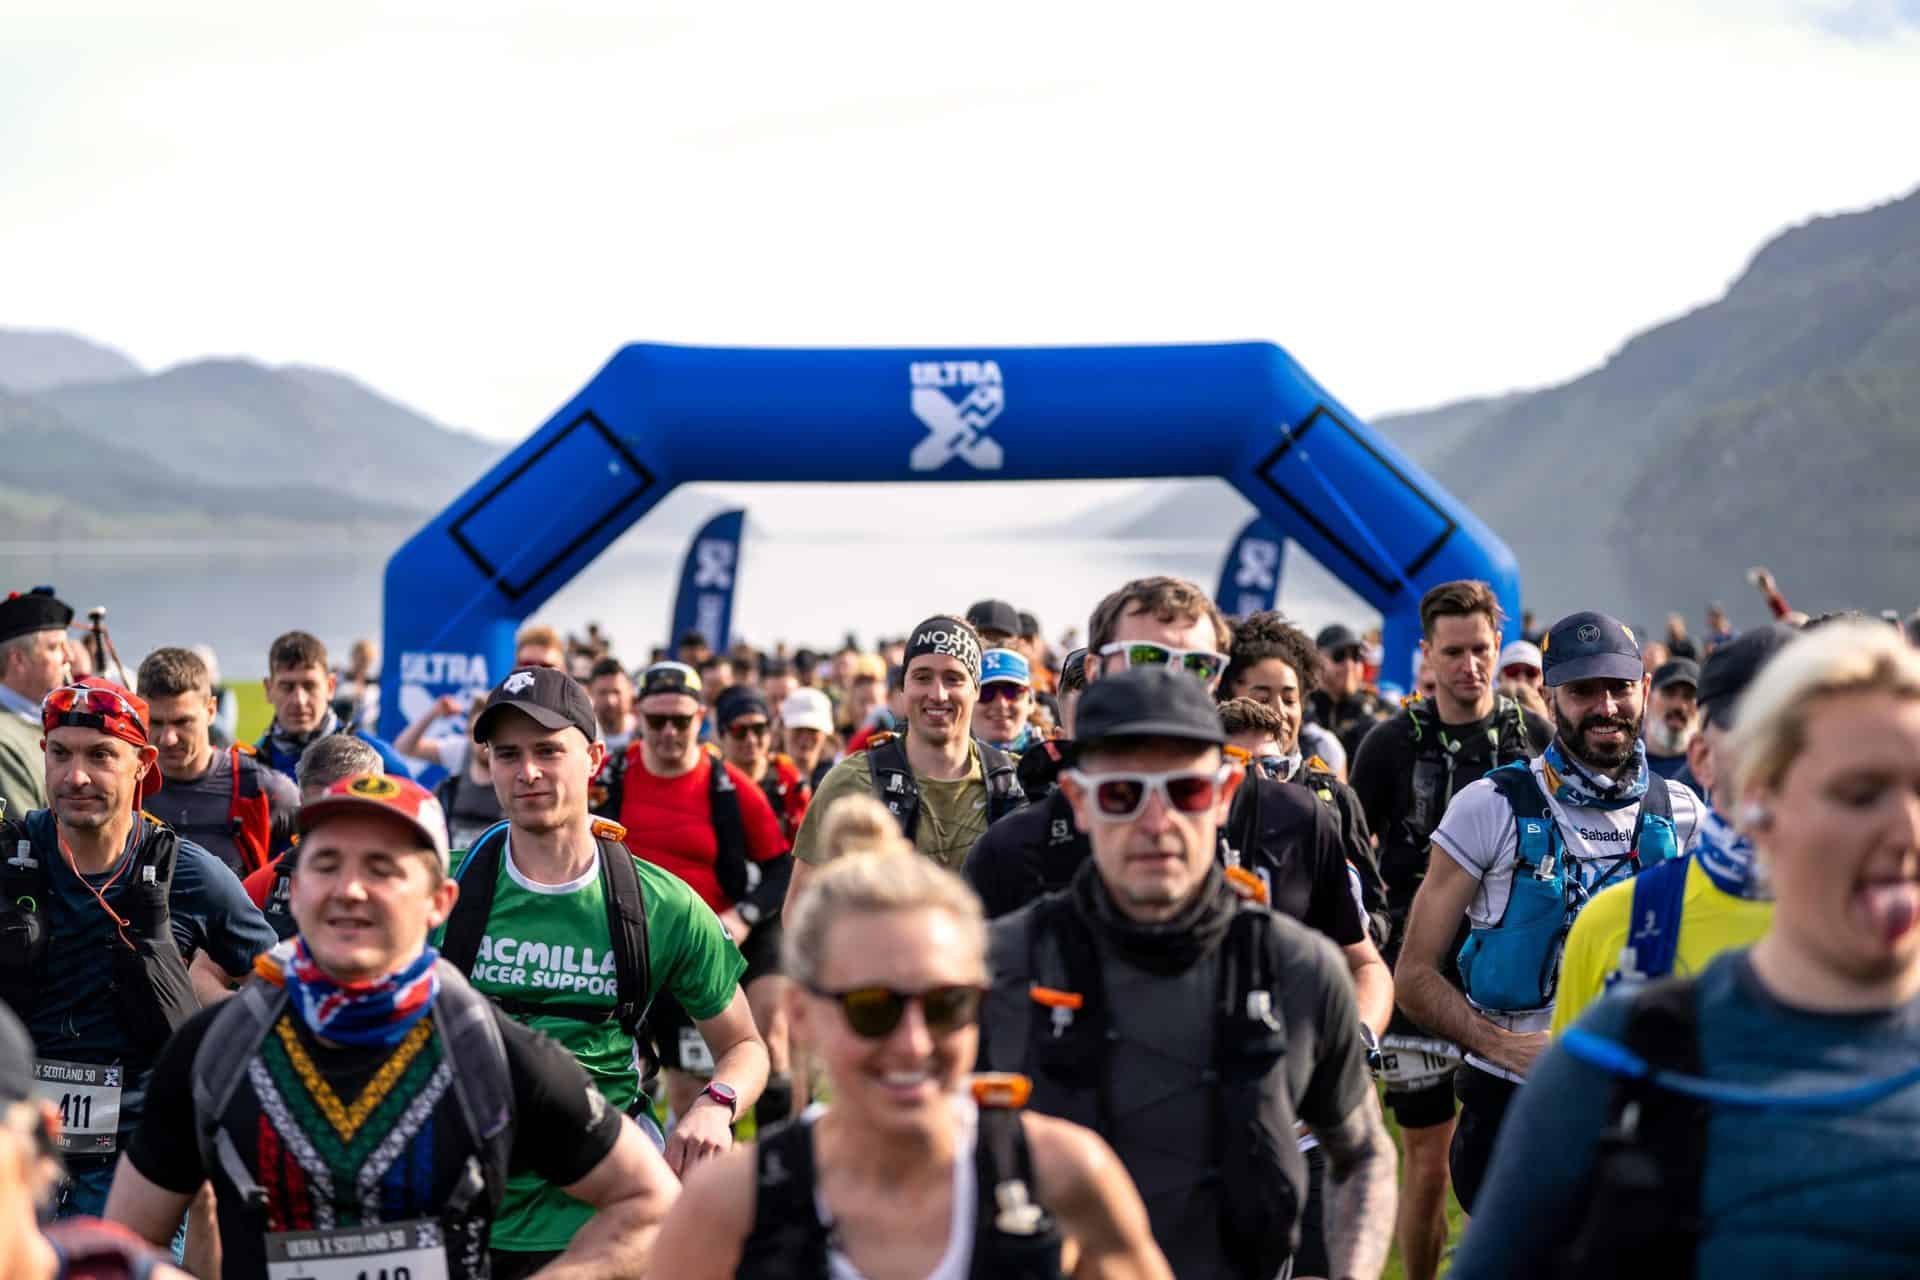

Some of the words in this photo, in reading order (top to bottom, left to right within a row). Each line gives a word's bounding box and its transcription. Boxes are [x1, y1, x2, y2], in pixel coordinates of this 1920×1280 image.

[909, 361, 1003, 388] ULTRA
[400, 653, 487, 685] ULTRA
[1580, 828, 1632, 842] Sabadell
[475, 935, 616, 975] ACMILLA
[470, 963, 526, 986] NCER
[531, 970, 618, 996] SUPPOR
[43, 1064, 84, 1081] SCOTLAND
[85, 1069, 96, 1082] 50
[60, 1093, 91, 1129] 411
